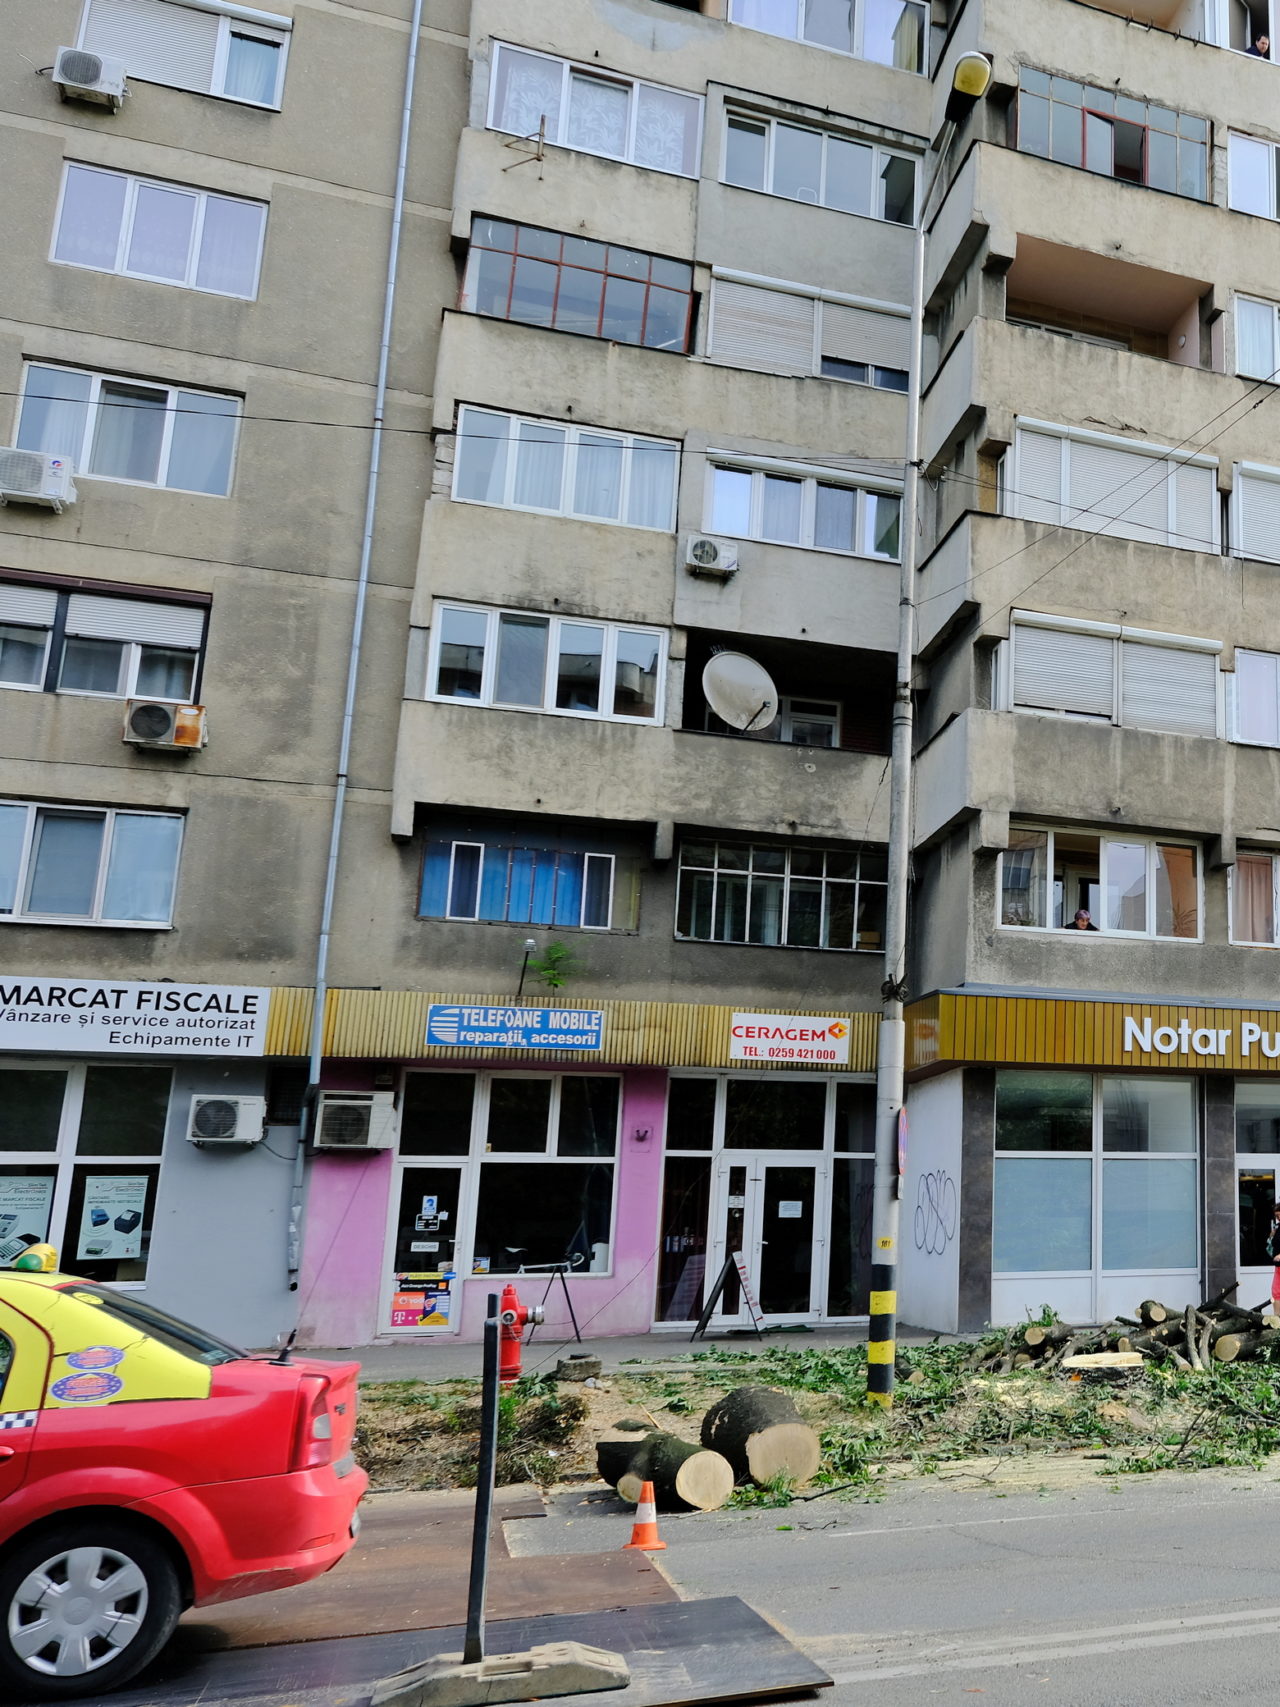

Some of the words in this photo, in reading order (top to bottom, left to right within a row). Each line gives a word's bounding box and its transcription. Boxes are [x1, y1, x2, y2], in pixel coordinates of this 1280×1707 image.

[0, 985, 128, 1009] MARCAT
[136, 990, 259, 1014] FISCALE
[101, 1014, 169, 1027] service
[176, 1017, 256, 1030] autorizat
[461, 1008, 541, 1028] TELEFOANE
[549, 1011, 600, 1030] MOBILE
[109, 1031, 231, 1048] Echipamente
[237, 1035, 254, 1047] IT
[531, 1032, 596, 1045] accesorii
[732, 1025, 826, 1042] CERAGEM
[1123, 1016, 1231, 1055] Notar
[768, 1047, 795, 1058] 0259
[796, 1049, 814, 1059] 421
[816, 1050, 836, 1060] 000
